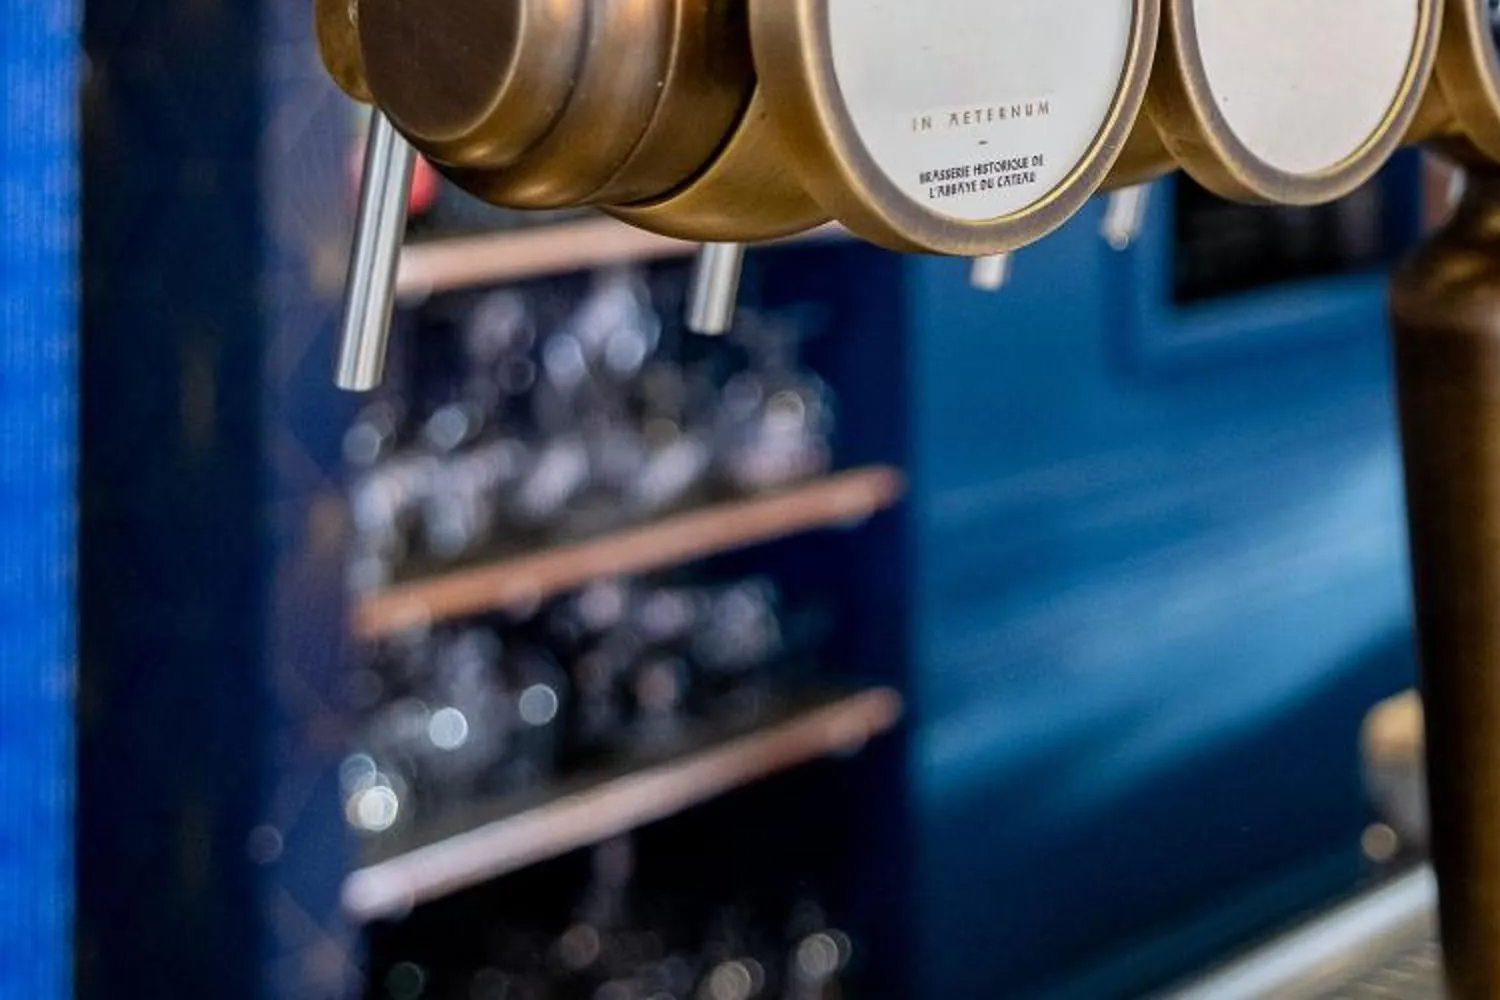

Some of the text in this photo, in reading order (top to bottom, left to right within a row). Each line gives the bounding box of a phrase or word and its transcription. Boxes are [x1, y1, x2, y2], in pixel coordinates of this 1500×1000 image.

[911, 101, 1050, 132] IN AETERNUM
[919, 164, 970, 184] BRASSERIE
[973, 156, 1029, 176] HISTORIQUE
[929, 179, 977, 199] L'ABBAYE
[997, 171, 1036, 188] CATEAU
